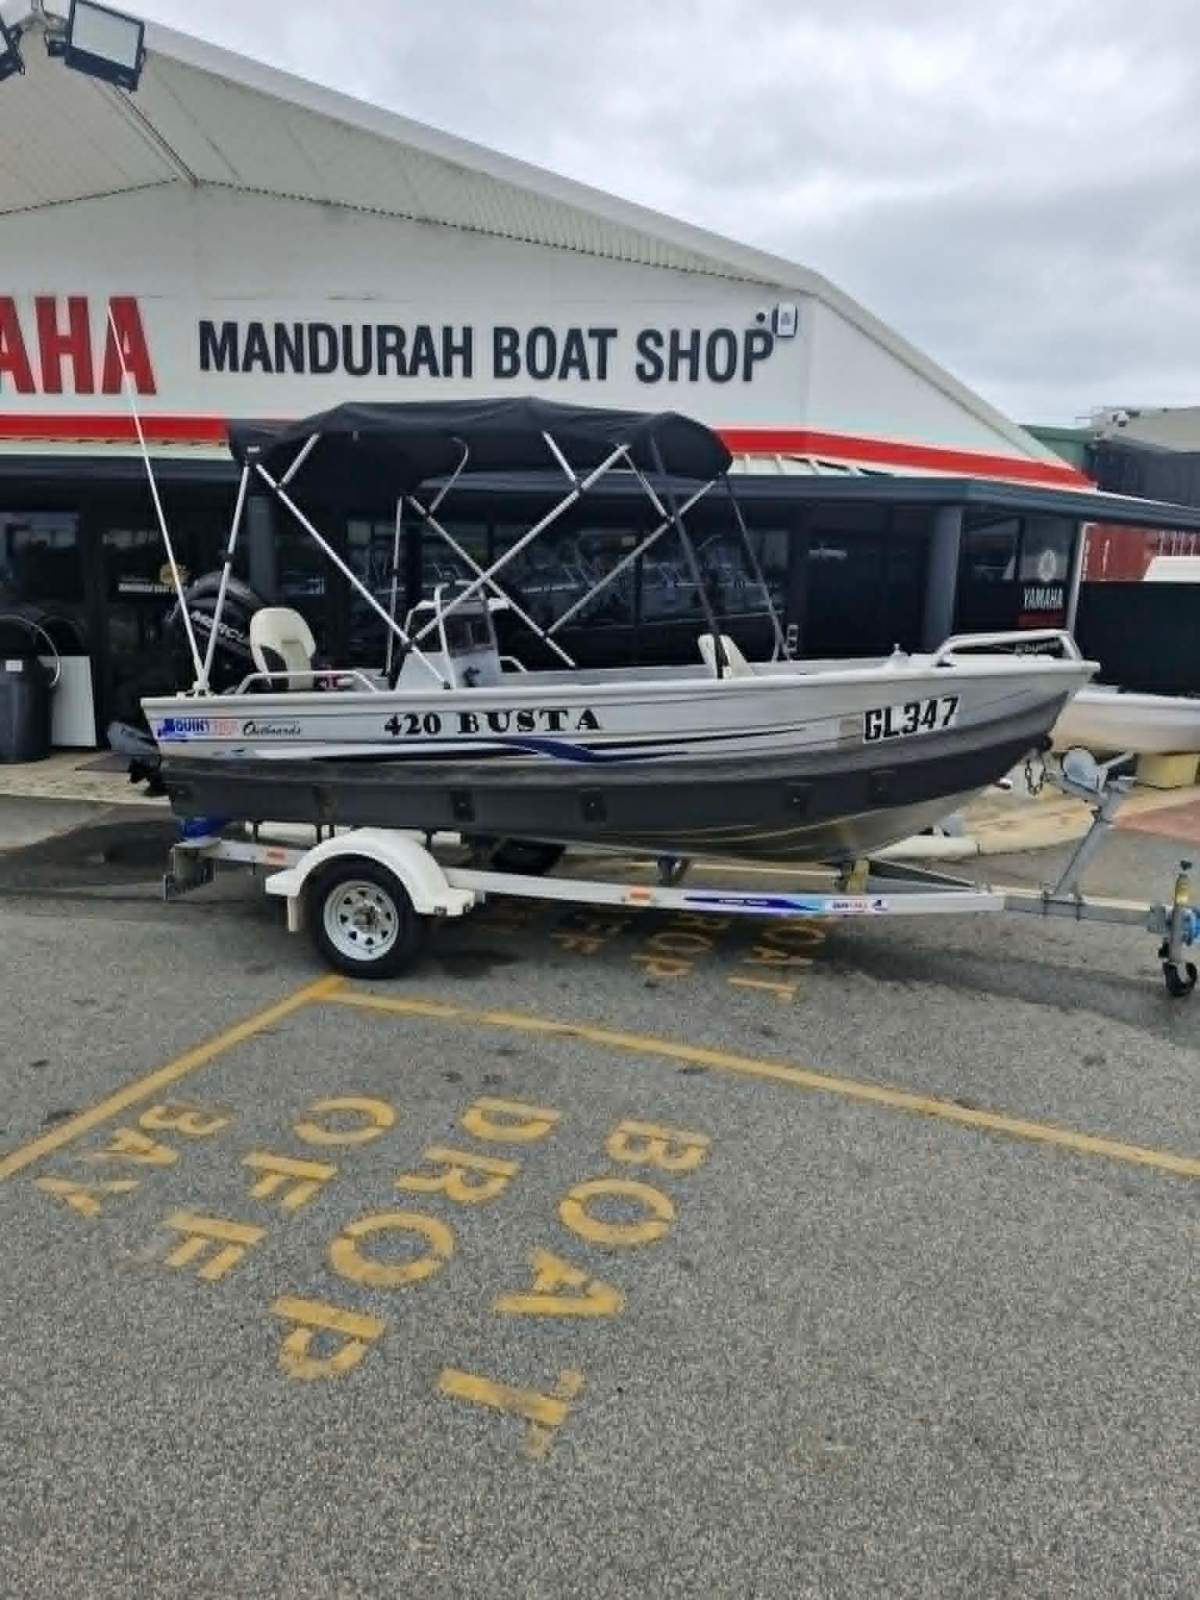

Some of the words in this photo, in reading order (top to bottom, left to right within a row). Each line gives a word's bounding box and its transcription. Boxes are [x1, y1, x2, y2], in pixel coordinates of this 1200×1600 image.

[200, 320, 473, 378] MANDURAH
[493, 326, 618, 381] BOAT
[635, 328, 774, 384] SHOP
[1023, 587, 1063, 609] YAMAHA
[384, 712, 441, 736] 420
[457, 708, 604, 733] BUSTA
[864, 697, 959, 740] GL347
[34, 1103, 230, 1217] BAY
[162, 1096, 396, 1281] OFF
[270, 1096, 561, 1381] DROP
[437, 1119, 711, 1459] BOAT
